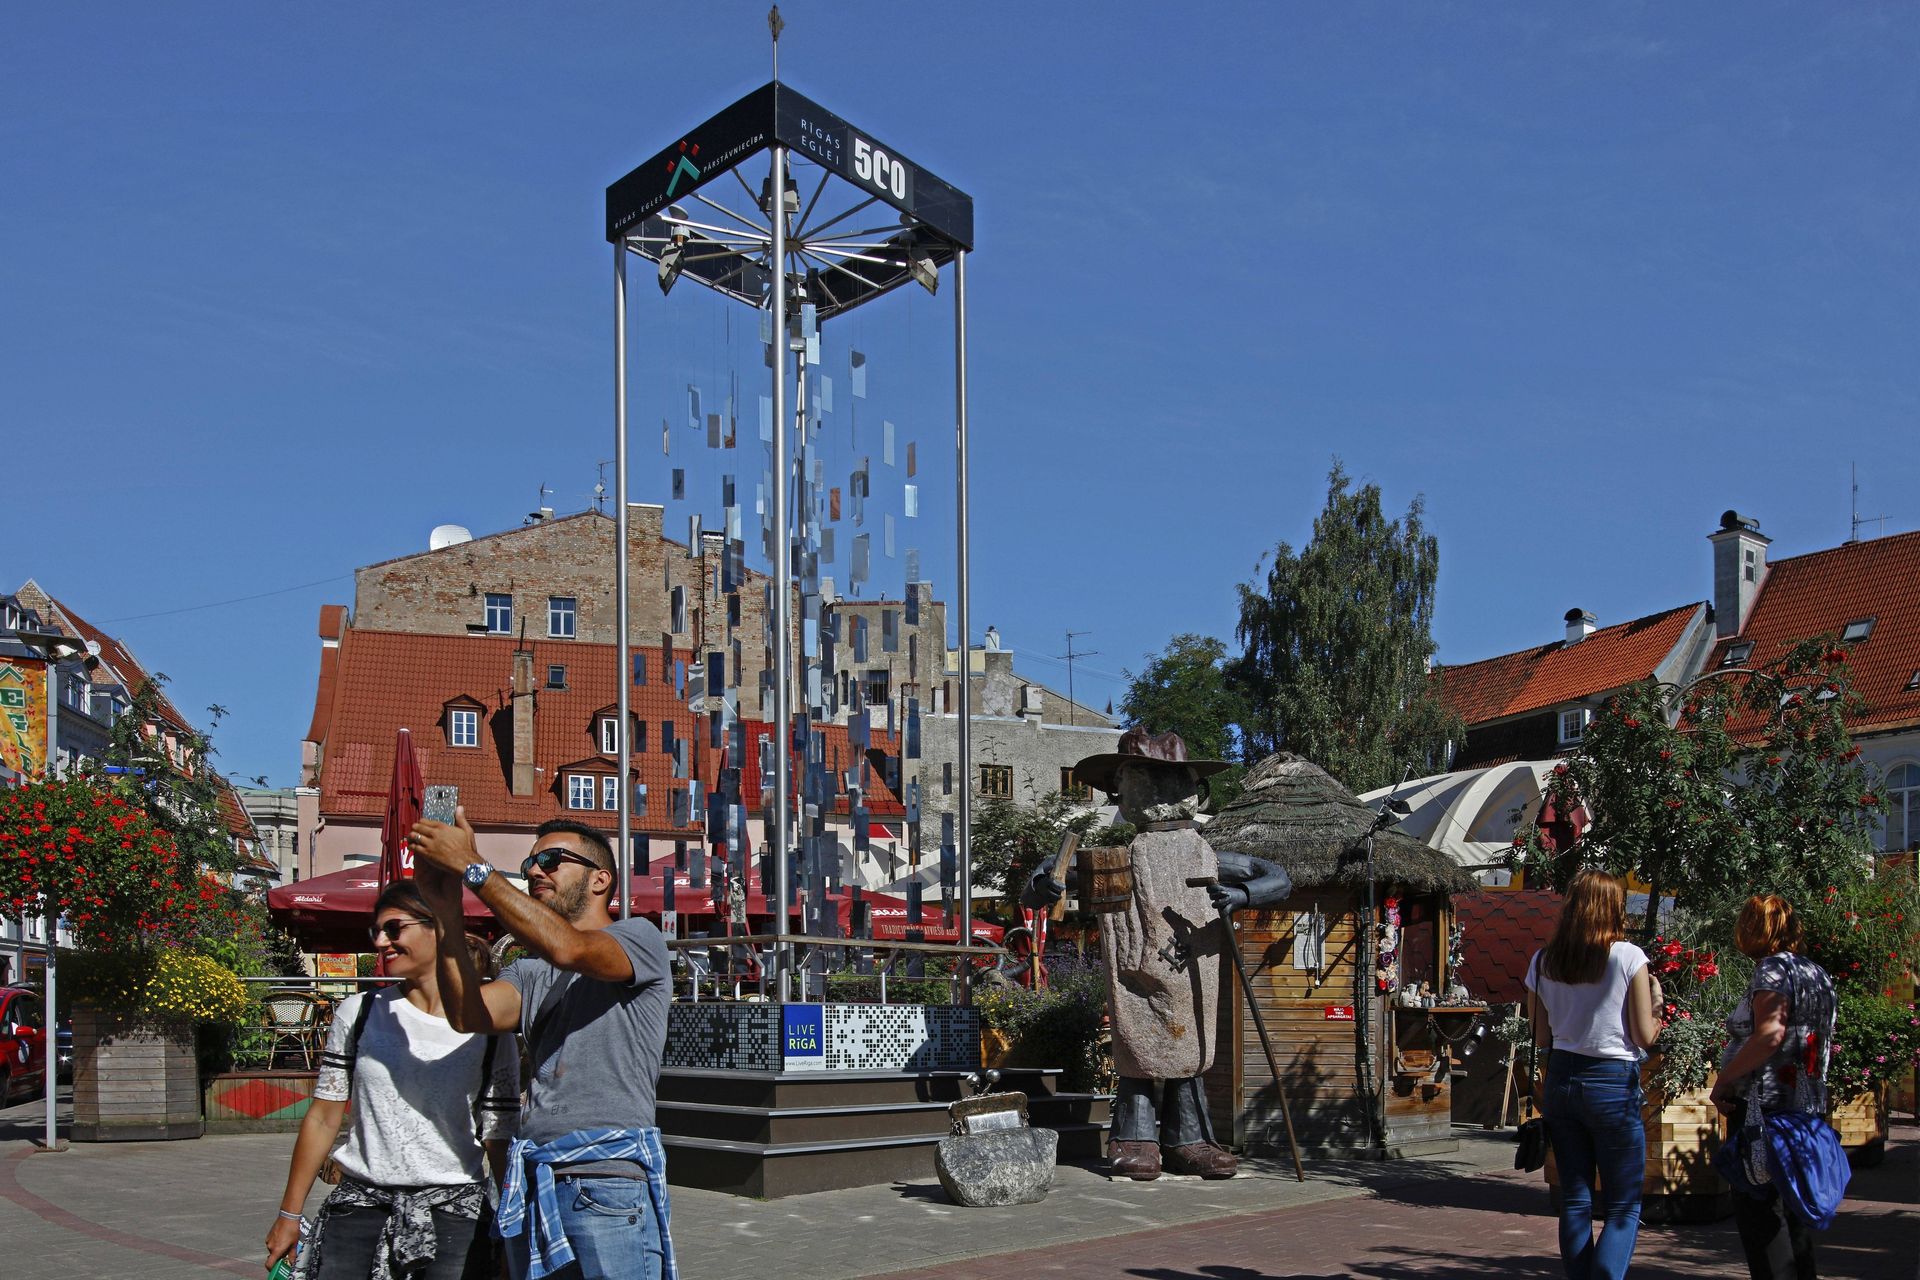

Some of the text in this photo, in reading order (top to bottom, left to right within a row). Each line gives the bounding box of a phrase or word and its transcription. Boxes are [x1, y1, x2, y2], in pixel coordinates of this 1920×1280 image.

[801, 119, 840, 149] RĪGAS
[801, 135, 839, 165] EGLEI
[641, 193, 663, 213] EGLES
[788, 1024, 816, 1036] LIVE
